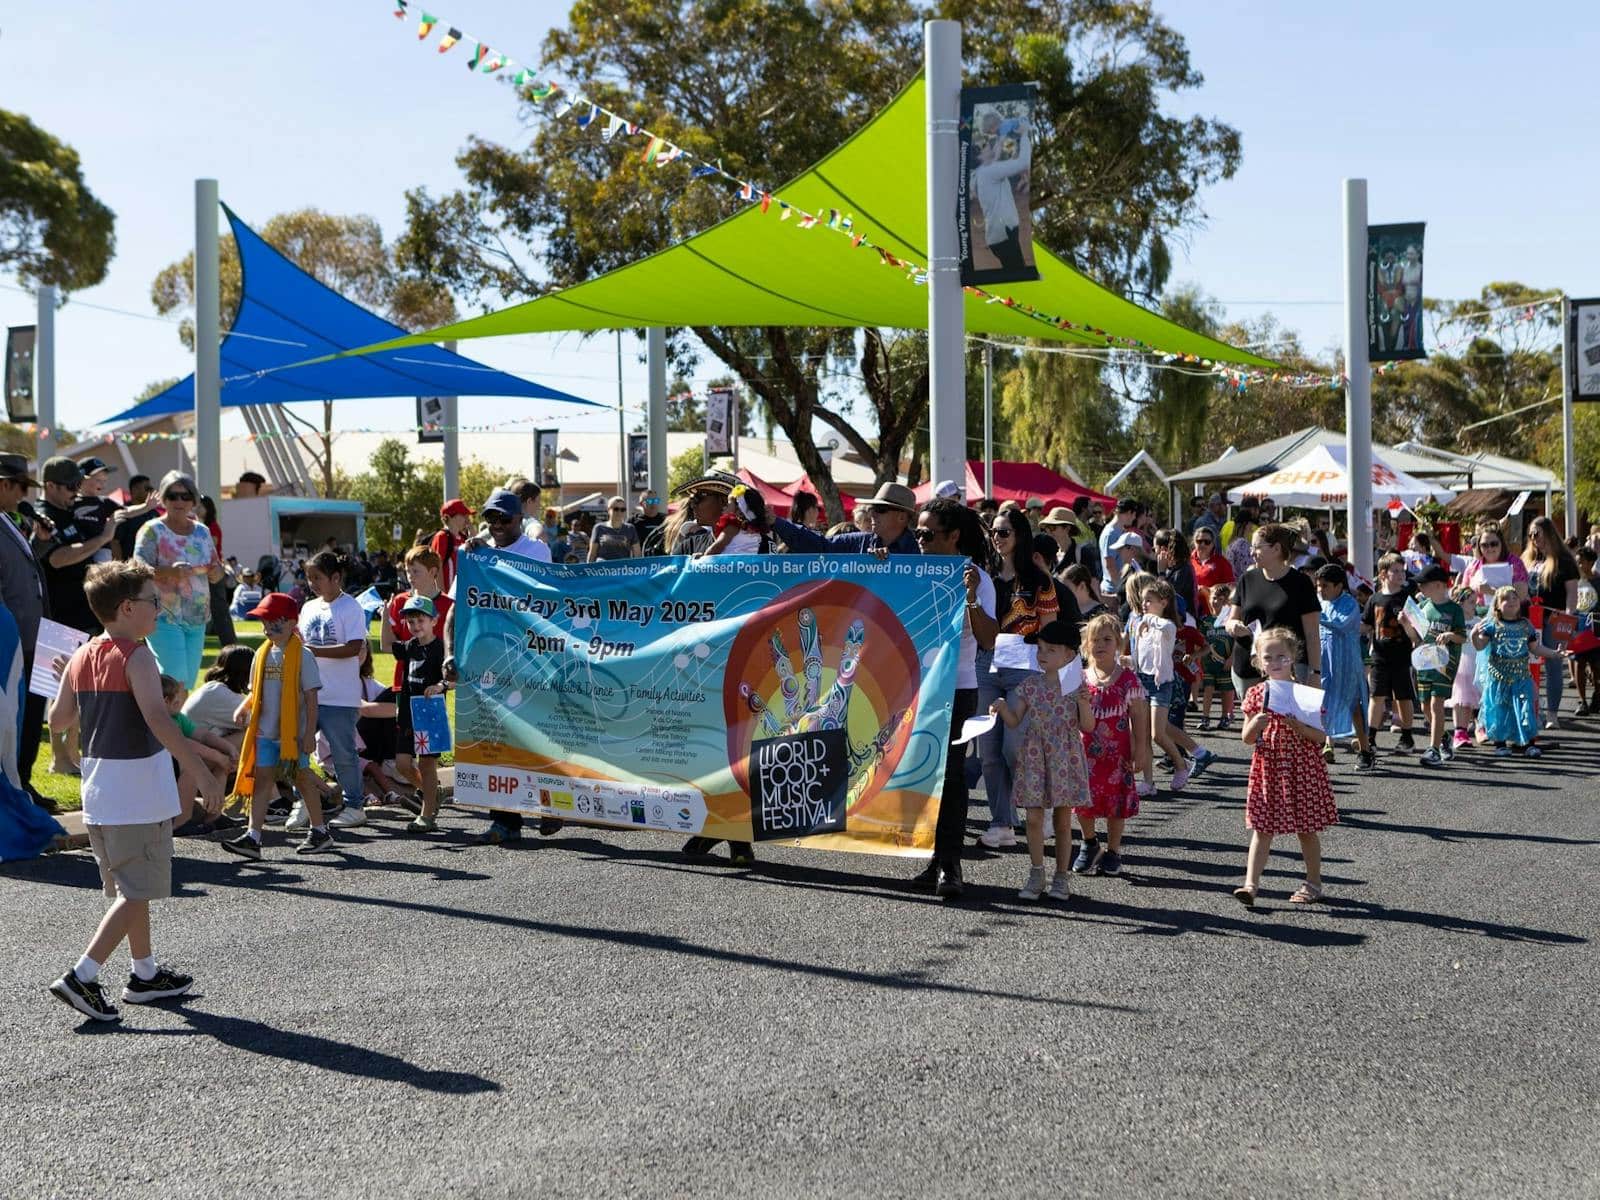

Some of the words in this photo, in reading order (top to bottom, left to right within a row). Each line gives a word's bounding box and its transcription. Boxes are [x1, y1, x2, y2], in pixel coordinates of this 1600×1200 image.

[959, 141, 969, 195] Community
[959, 197, 967, 231] Vibrant
[960, 232, 969, 260] Young
[1269, 470, 1340, 485] BHP
[585, 564, 648, 577] Richardson
[650, 562, 678, 575] Plae
[737, 561, 760, 576] Pop
[763, 561, 779, 576] Up
[783, 561, 804, 574] Bar
[807, 561, 839, 576] (BYO
[842, 561, 891, 574] allowed
[895, 564, 912, 574] no
[915, 562, 955, 577] glass)
[467, 586, 558, 619] Saturday
[564, 599, 601, 619] 3rd
[607, 600, 654, 627] May
[660, 601, 716, 622] 2025
[526, 629, 566, 655] 2pm
[587, 636, 635, 660] 9pm
[585, 681, 615, 697] Dance
[630, 684, 662, 704] Family
[662, 687, 706, 703] Activities
[759, 739, 827, 767] WORLD
[488, 774, 519, 795] BHP
[761, 782, 824, 811] MUSIC
[762, 801, 837, 831] FESTIVAL
